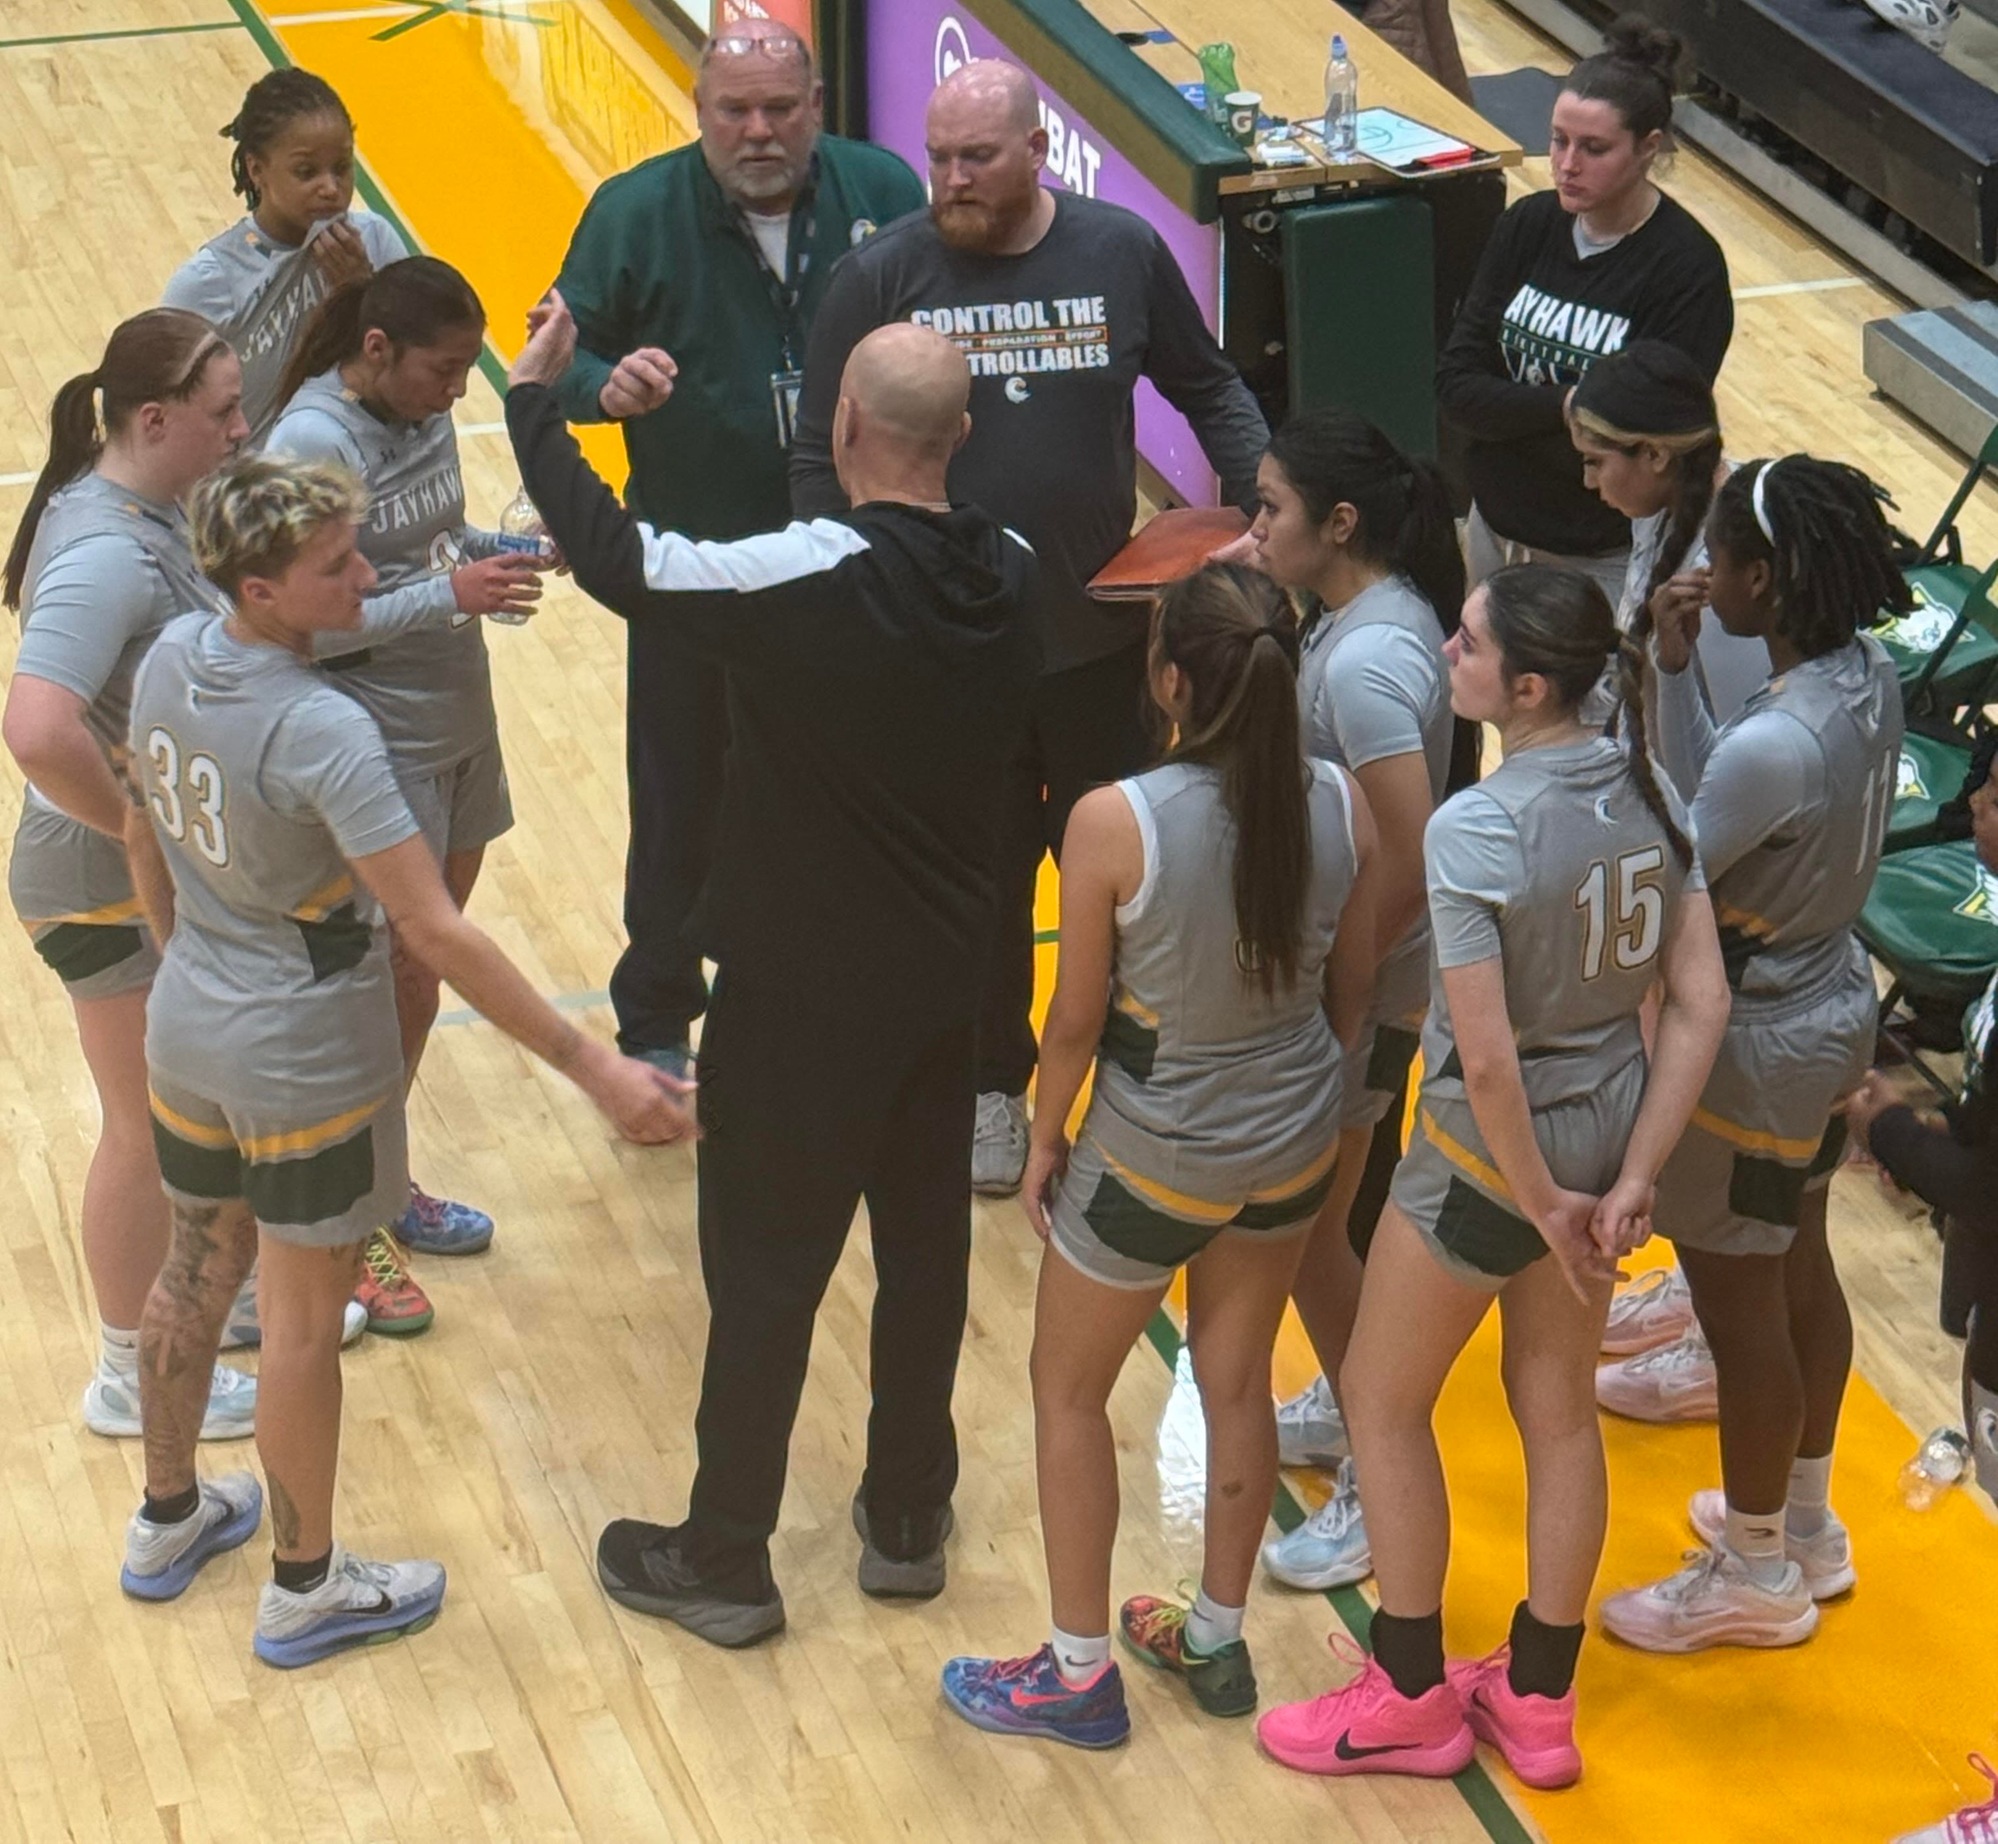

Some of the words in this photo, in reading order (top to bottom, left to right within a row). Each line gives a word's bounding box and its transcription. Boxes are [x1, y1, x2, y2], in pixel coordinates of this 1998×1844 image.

[911, 301, 1050, 335] CONTROL
[1053, 296, 1106, 326] THE
[966, 344, 1110, 376] TROLLABLES
[1503, 284, 1631, 355] AYHAWK
[147, 726, 230, 868] 33
[1854, 748, 1891, 876] 11
[1574, 844, 1665, 982] 15
